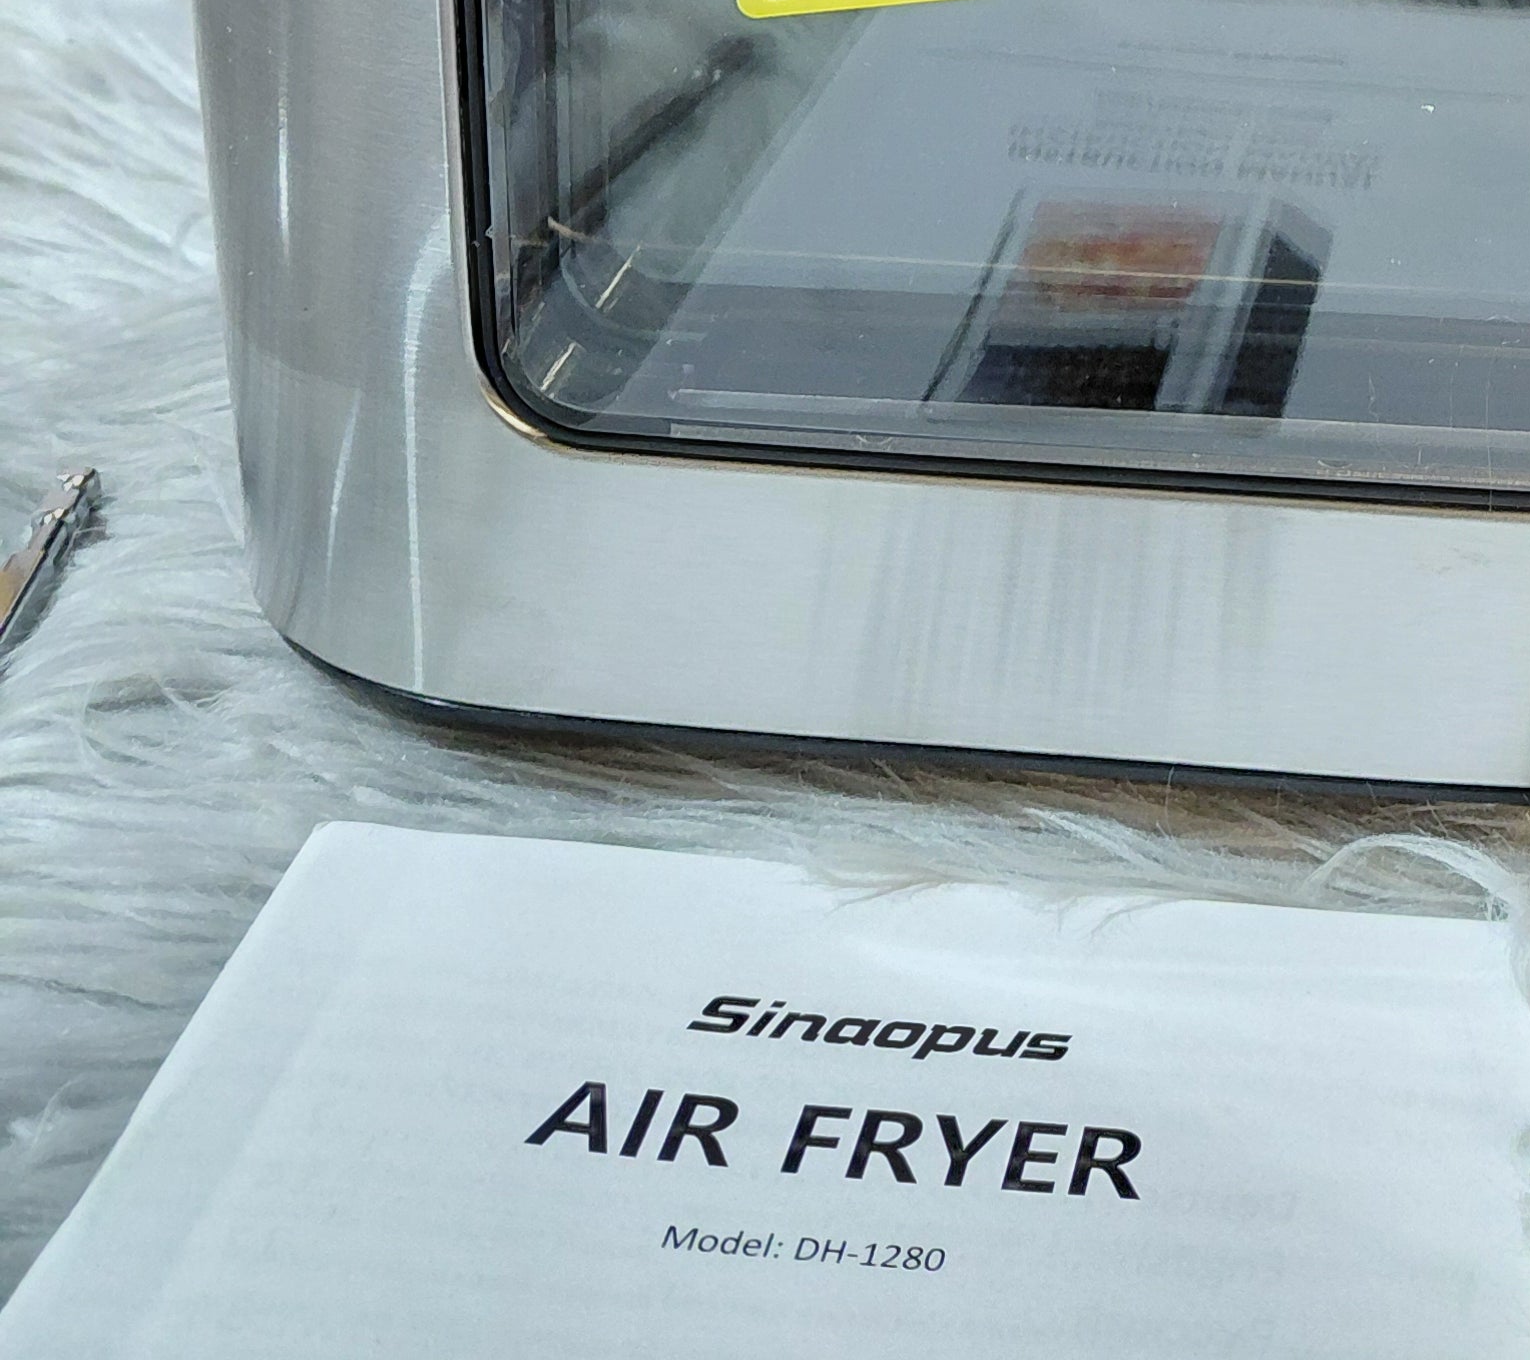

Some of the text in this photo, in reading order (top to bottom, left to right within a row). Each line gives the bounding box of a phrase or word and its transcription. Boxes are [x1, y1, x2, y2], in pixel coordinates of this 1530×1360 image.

[686, 994, 1074, 1062] Sinaopus
[524, 1080, 1143, 1201] AIR FRYER
[660, 1224, 946, 1273] Model: DH-1280
